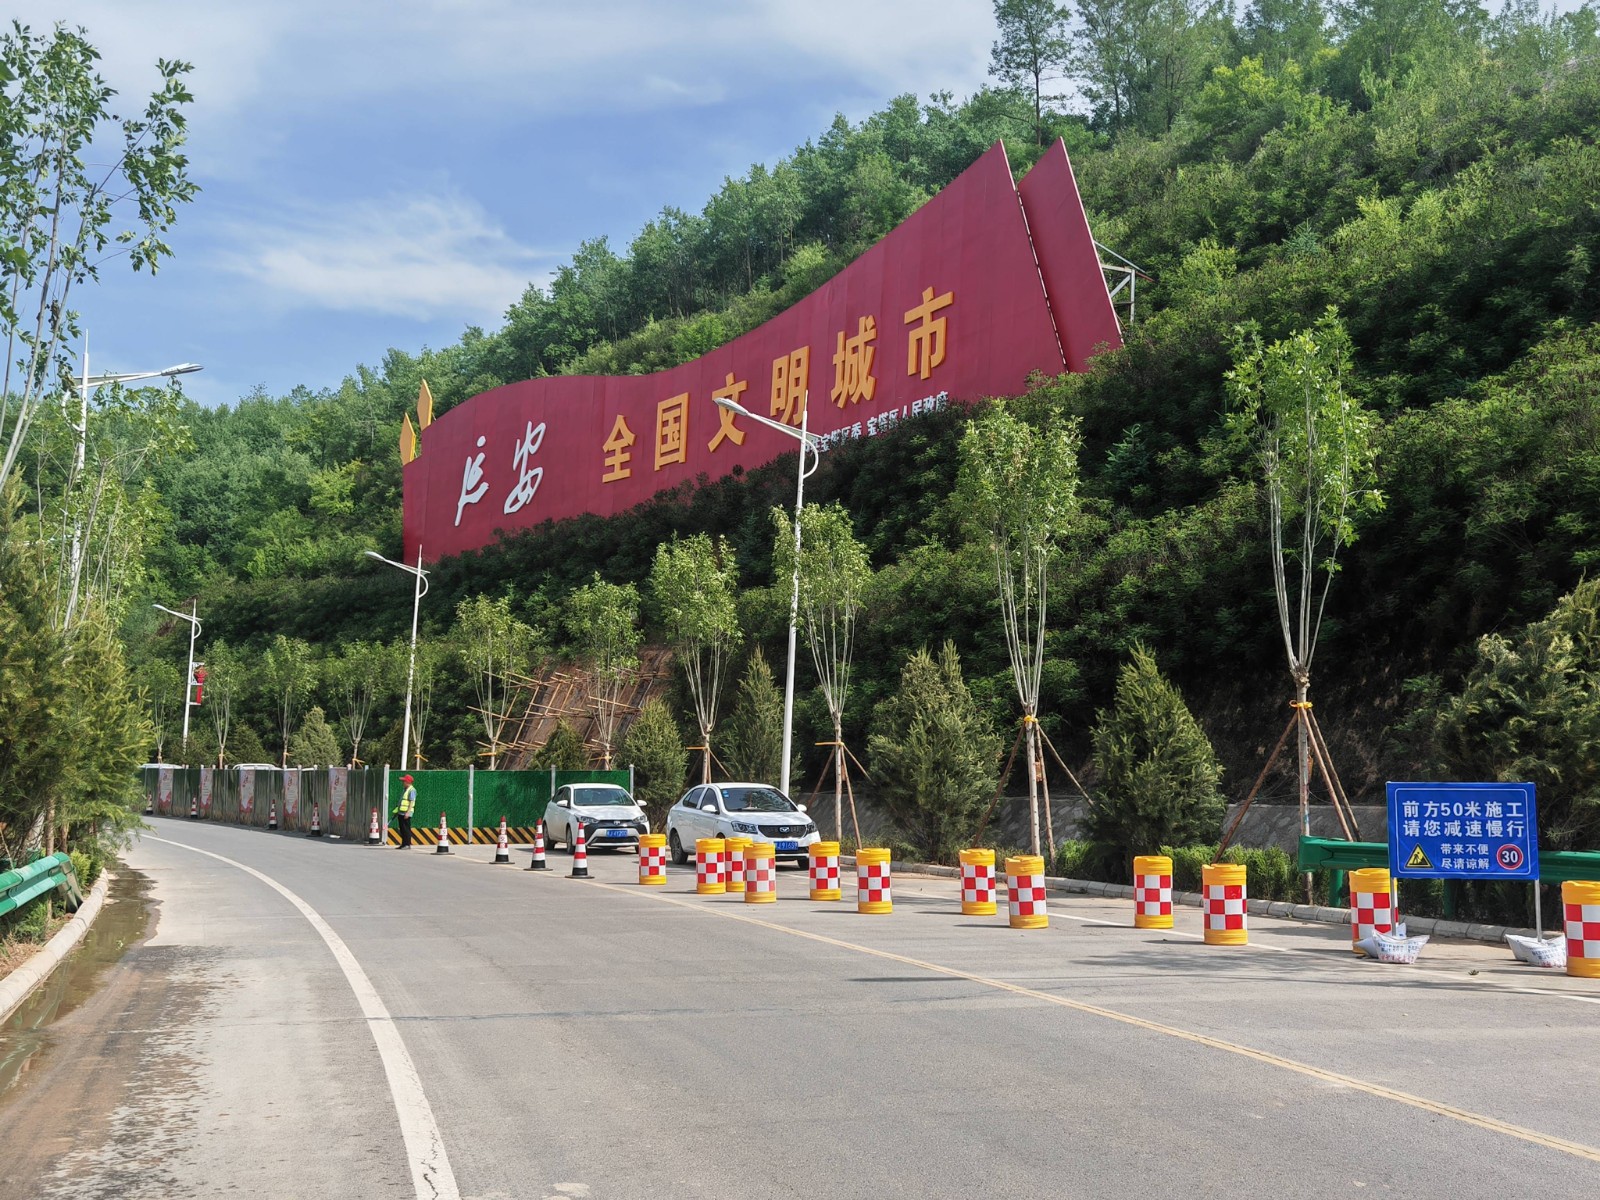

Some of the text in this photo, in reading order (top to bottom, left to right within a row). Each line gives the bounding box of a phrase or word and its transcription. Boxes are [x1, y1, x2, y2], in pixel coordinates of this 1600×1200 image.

[602, 286, 954, 483] 全国文明城市
[1403, 800, 1524, 818] 前方50米施工
[1404, 819, 1525, 838] 请您减速慢行
[1440, 843, 1489, 856] 带来不便
[1502, 850, 1519, 864] 30
[1441, 858, 1490, 870] 尽请谅解
